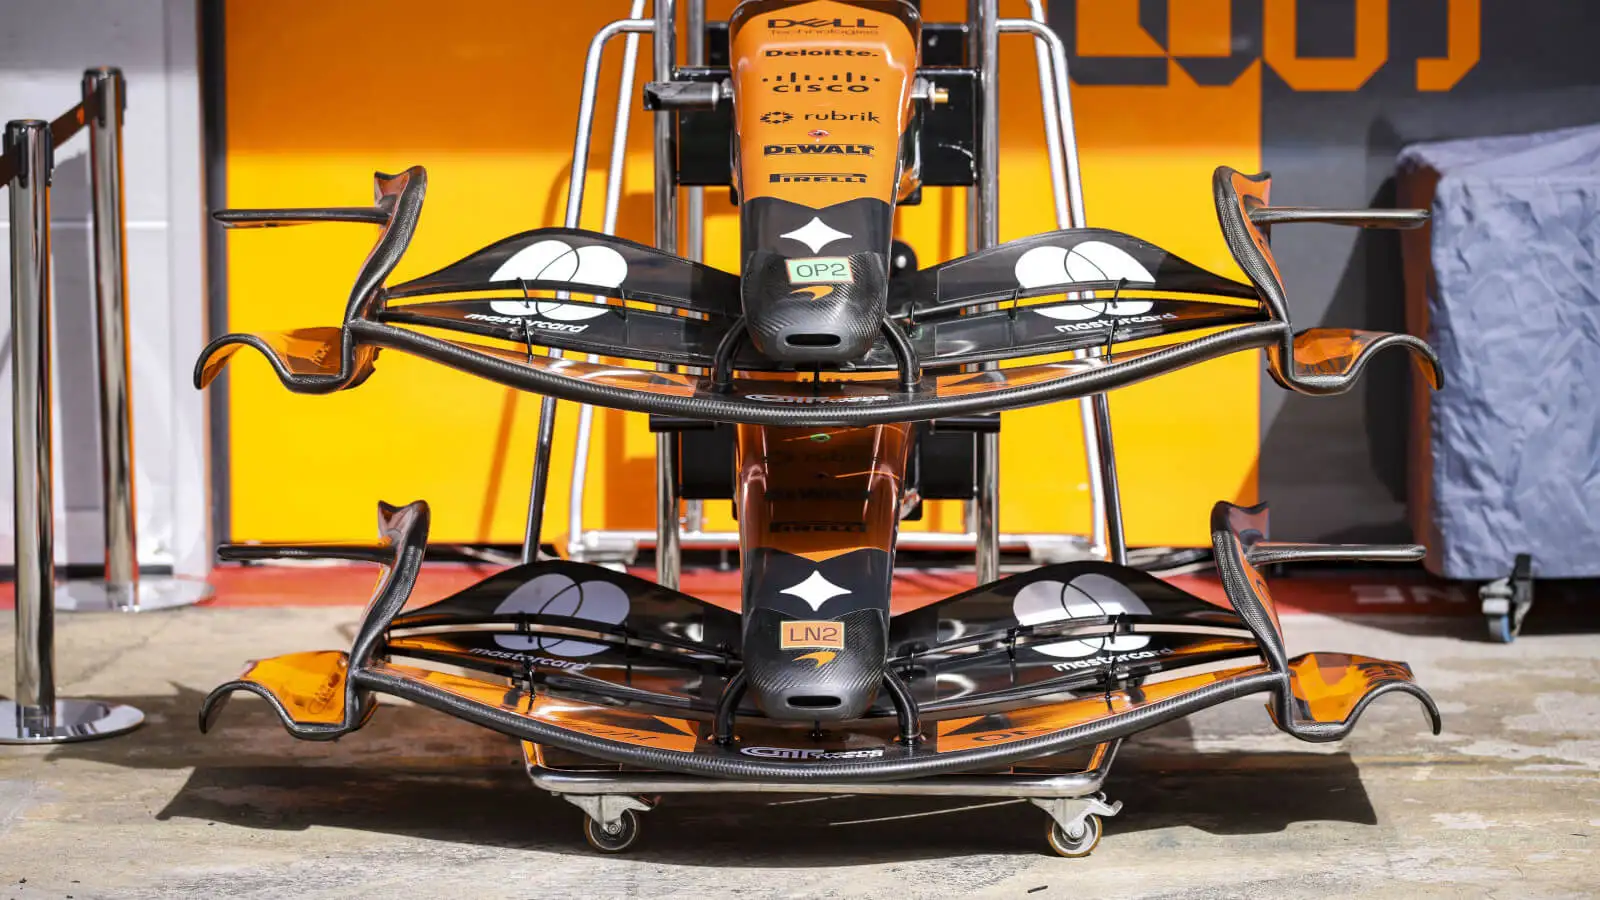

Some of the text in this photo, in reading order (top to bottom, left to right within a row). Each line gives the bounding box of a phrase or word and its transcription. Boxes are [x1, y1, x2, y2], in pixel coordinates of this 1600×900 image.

[767, 18, 879, 29] DELL
[804, 111, 880, 123] rubrik
[769, 172, 868, 183] PIRELLI
[796, 263, 848, 278] OP2
[789, 627, 838, 642] LN2
